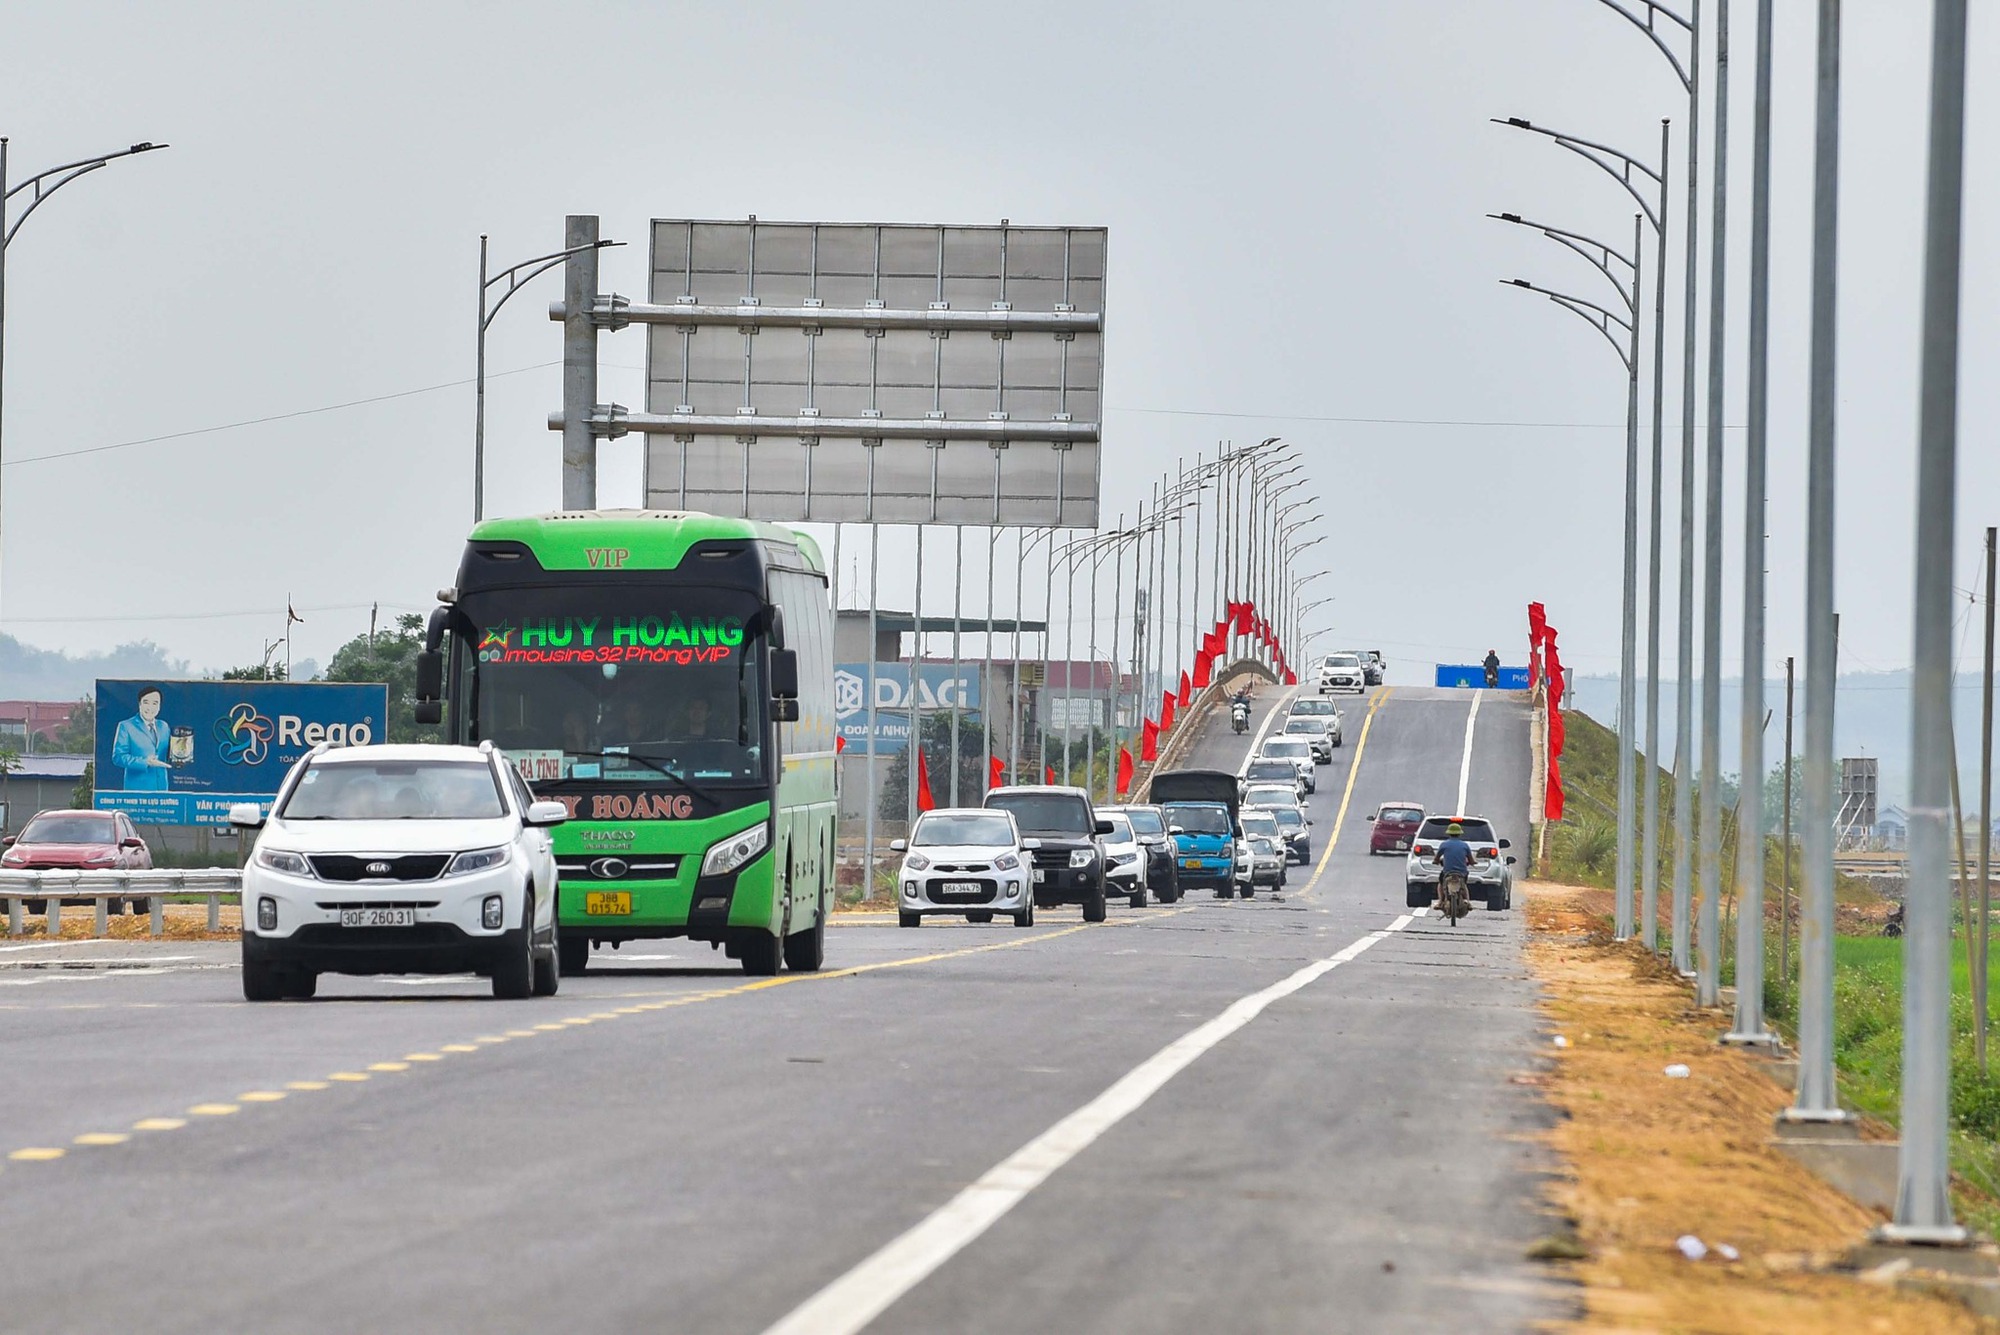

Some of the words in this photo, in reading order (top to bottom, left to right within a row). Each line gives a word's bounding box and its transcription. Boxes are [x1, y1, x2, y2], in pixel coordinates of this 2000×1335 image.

[585, 549, 629, 568] VIP
[521, 616, 602, 647] HUY
[612, 610, 744, 647] HOÀNG
[875, 678, 968, 708] DAG
[278, 715, 372, 747] Rego
[520, 752, 534, 779] HÀ
[536, 752, 559, 779] TĨNH
[196, 800, 213, 810] VĂN
[215, 801, 236, 811] PHÒ
[580, 830, 636, 841] THACO
